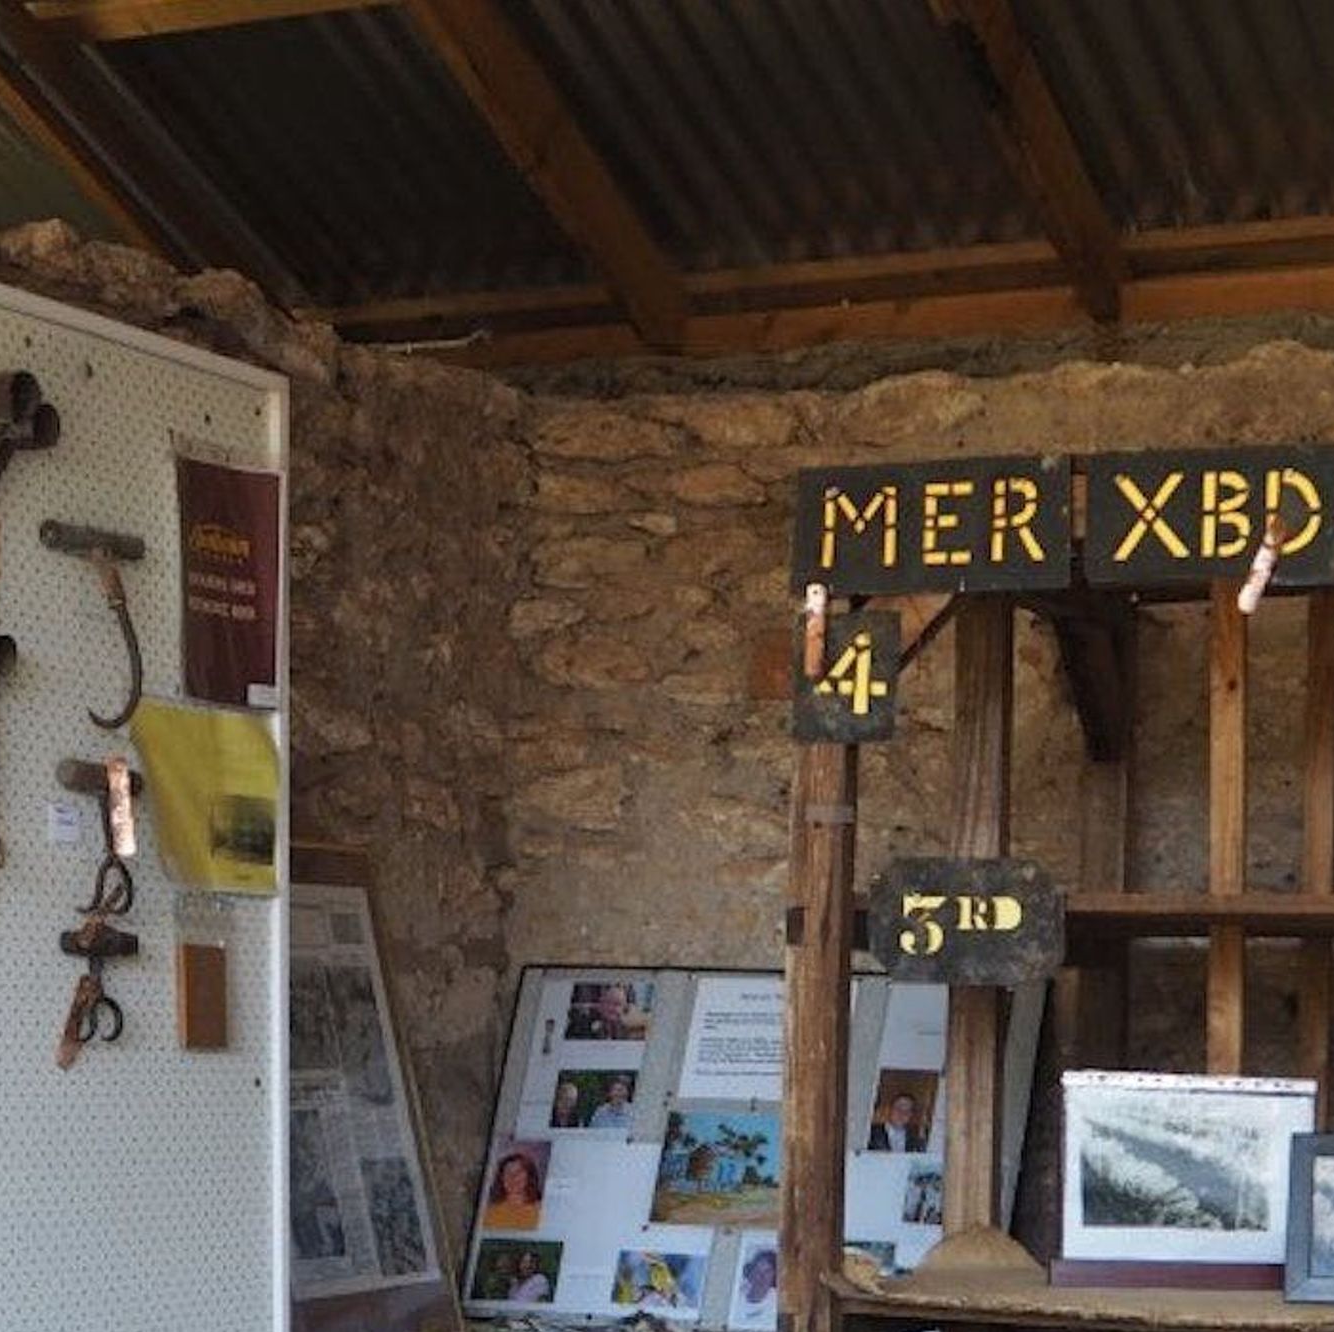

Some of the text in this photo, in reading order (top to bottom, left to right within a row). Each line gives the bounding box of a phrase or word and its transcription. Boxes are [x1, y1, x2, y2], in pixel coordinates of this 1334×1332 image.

[820, 477, 1046, 570] MER
[1113, 468, 1323, 562] XBD
[815, 632, 887, 716] 4
[898, 892, 1023, 956] 3RD
